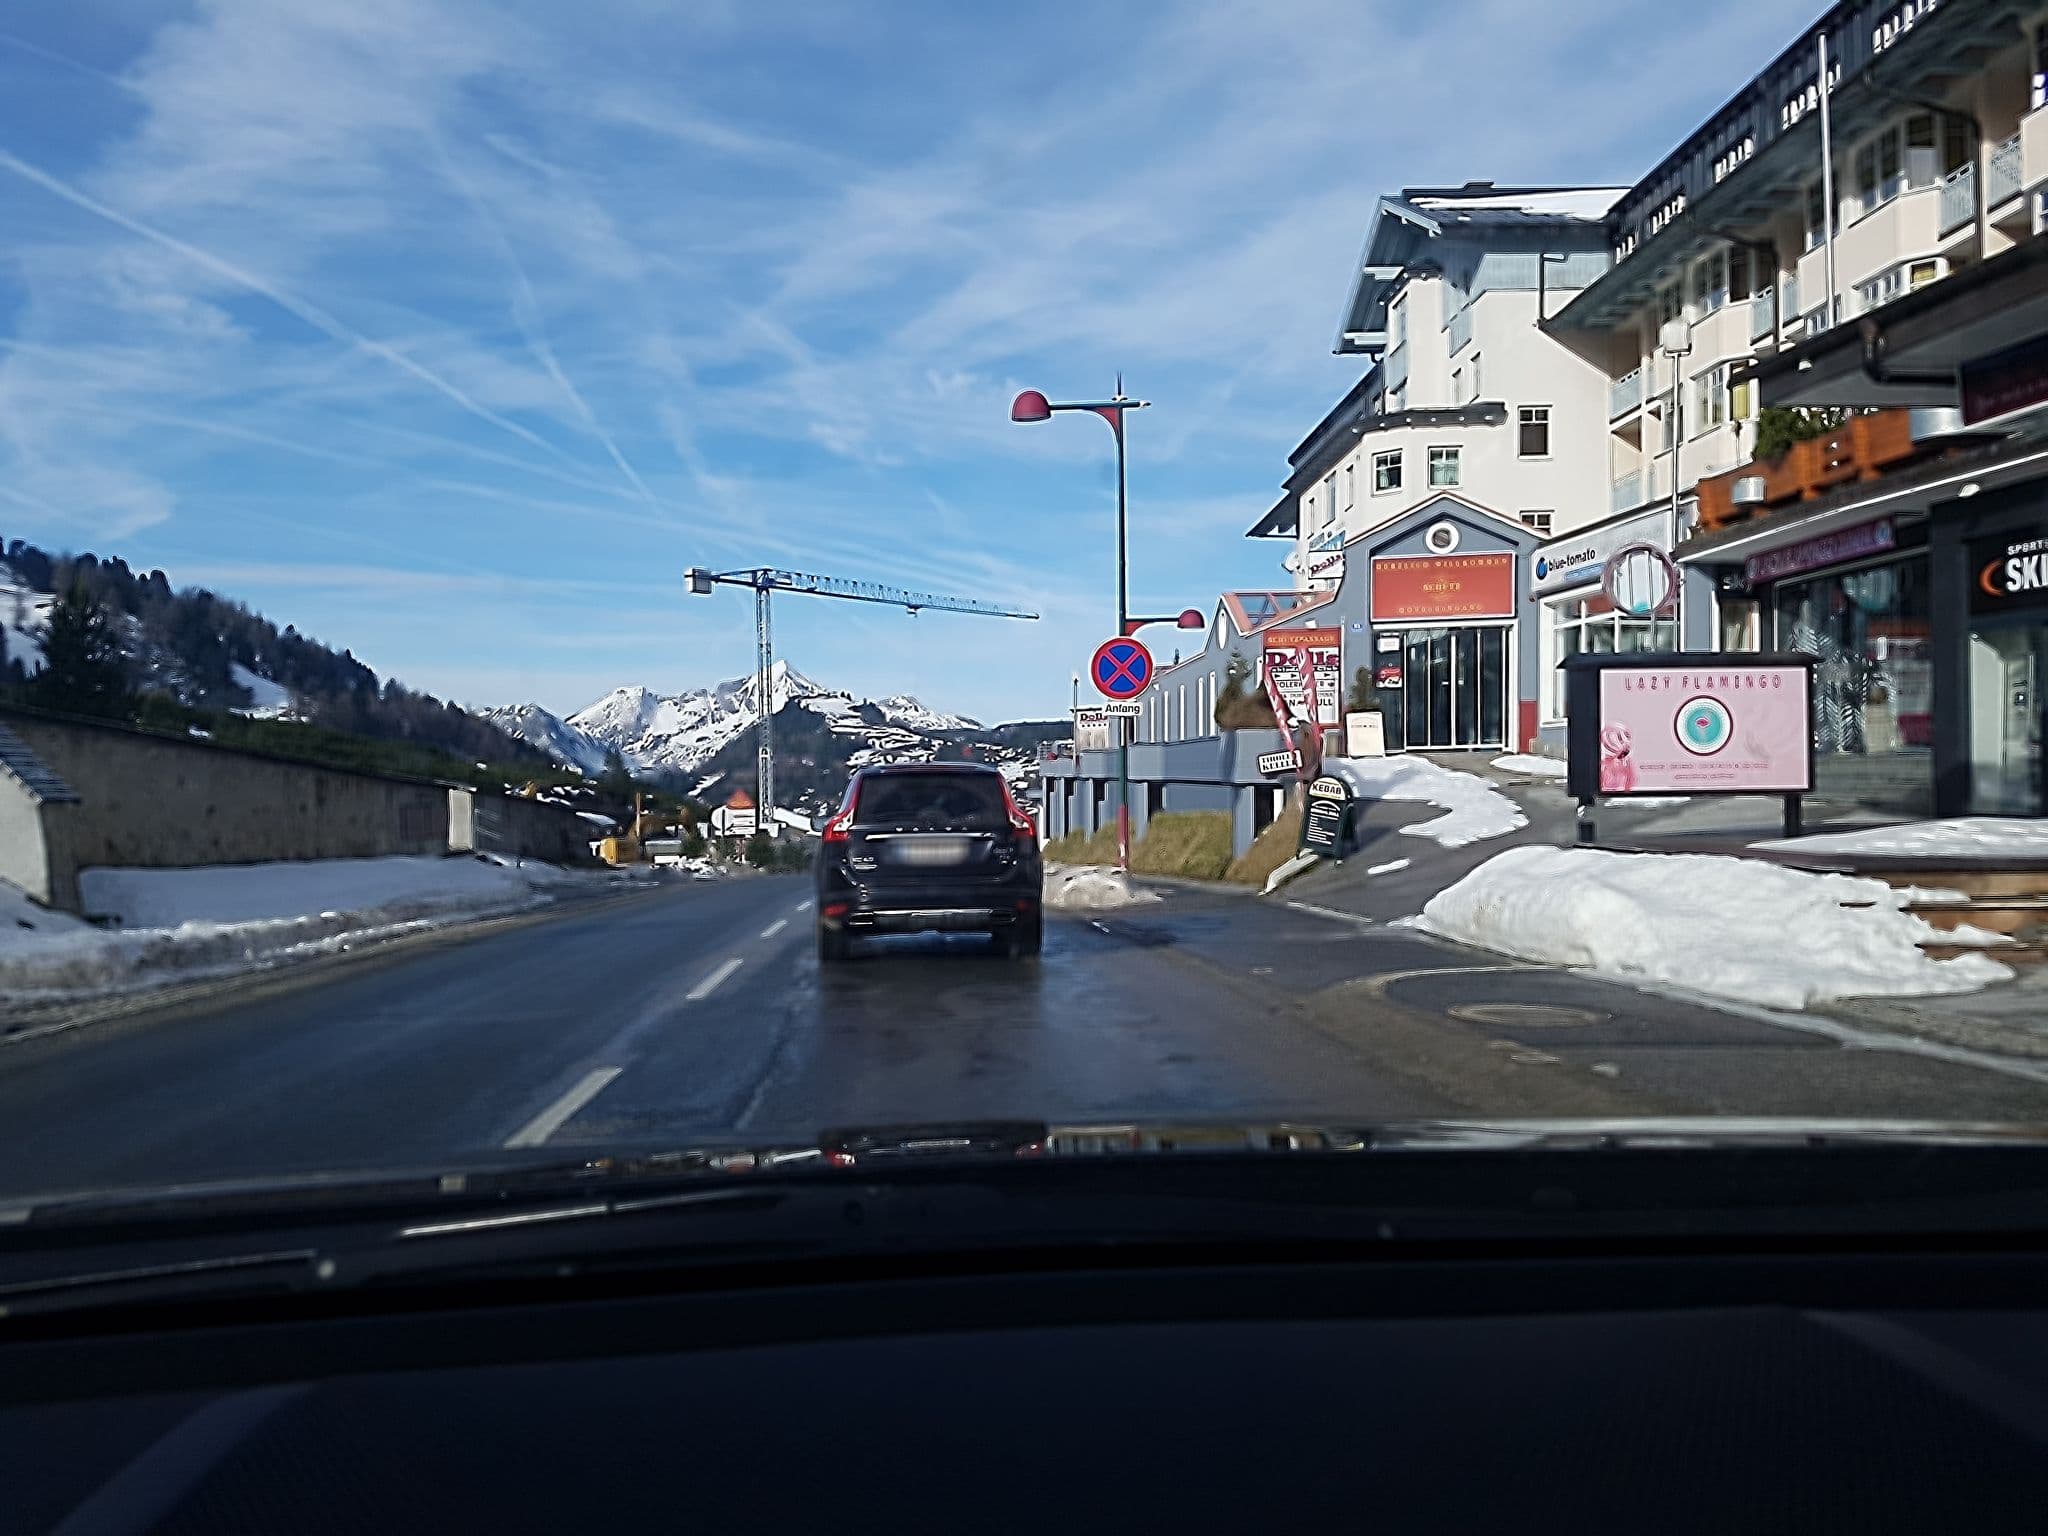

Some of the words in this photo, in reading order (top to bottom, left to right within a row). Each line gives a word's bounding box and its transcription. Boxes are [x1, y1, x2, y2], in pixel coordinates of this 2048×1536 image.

[1548, 549, 1596, 571] blue-tomato
[1625, 676, 1670, 690] LAZY
[1682, 675, 1782, 690] FLAMINGO
[1105, 704, 1140, 714] Anfang
[1312, 784, 1342, 795] KEBAB
